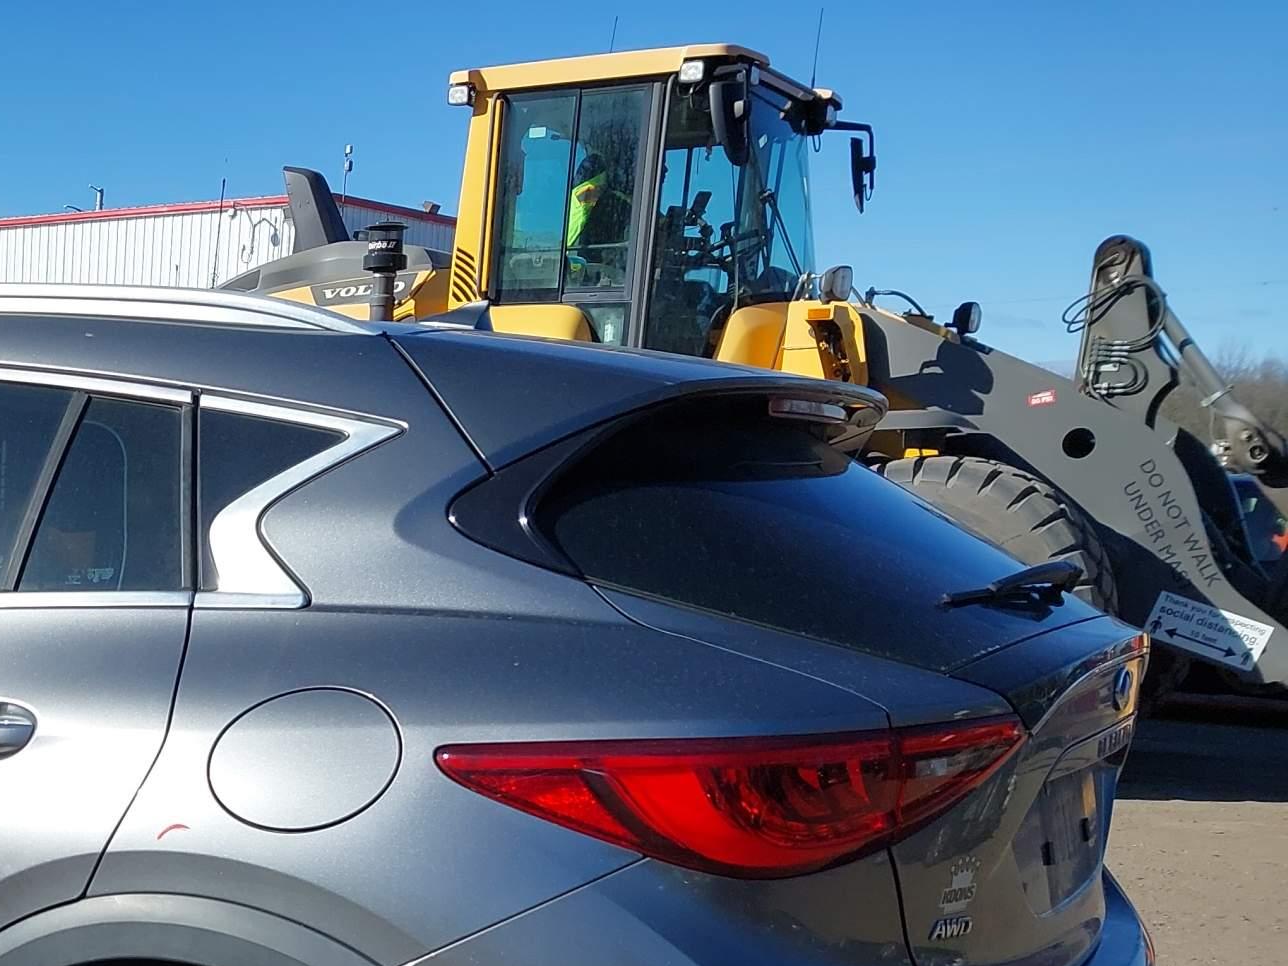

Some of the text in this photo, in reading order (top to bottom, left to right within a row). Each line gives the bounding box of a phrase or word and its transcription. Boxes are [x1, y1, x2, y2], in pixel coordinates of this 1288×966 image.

[322, 281, 406, 299] VOLO
[1123, 480, 1165, 544] UNDER
[1139, 458, 1222, 588] DO NOT WALK
[1159, 606, 1195, 622] social
[1165, 595, 1188, 608] Thank
[1191, 605, 1207, 615] you
[928, 916, 973, 941] AWD
